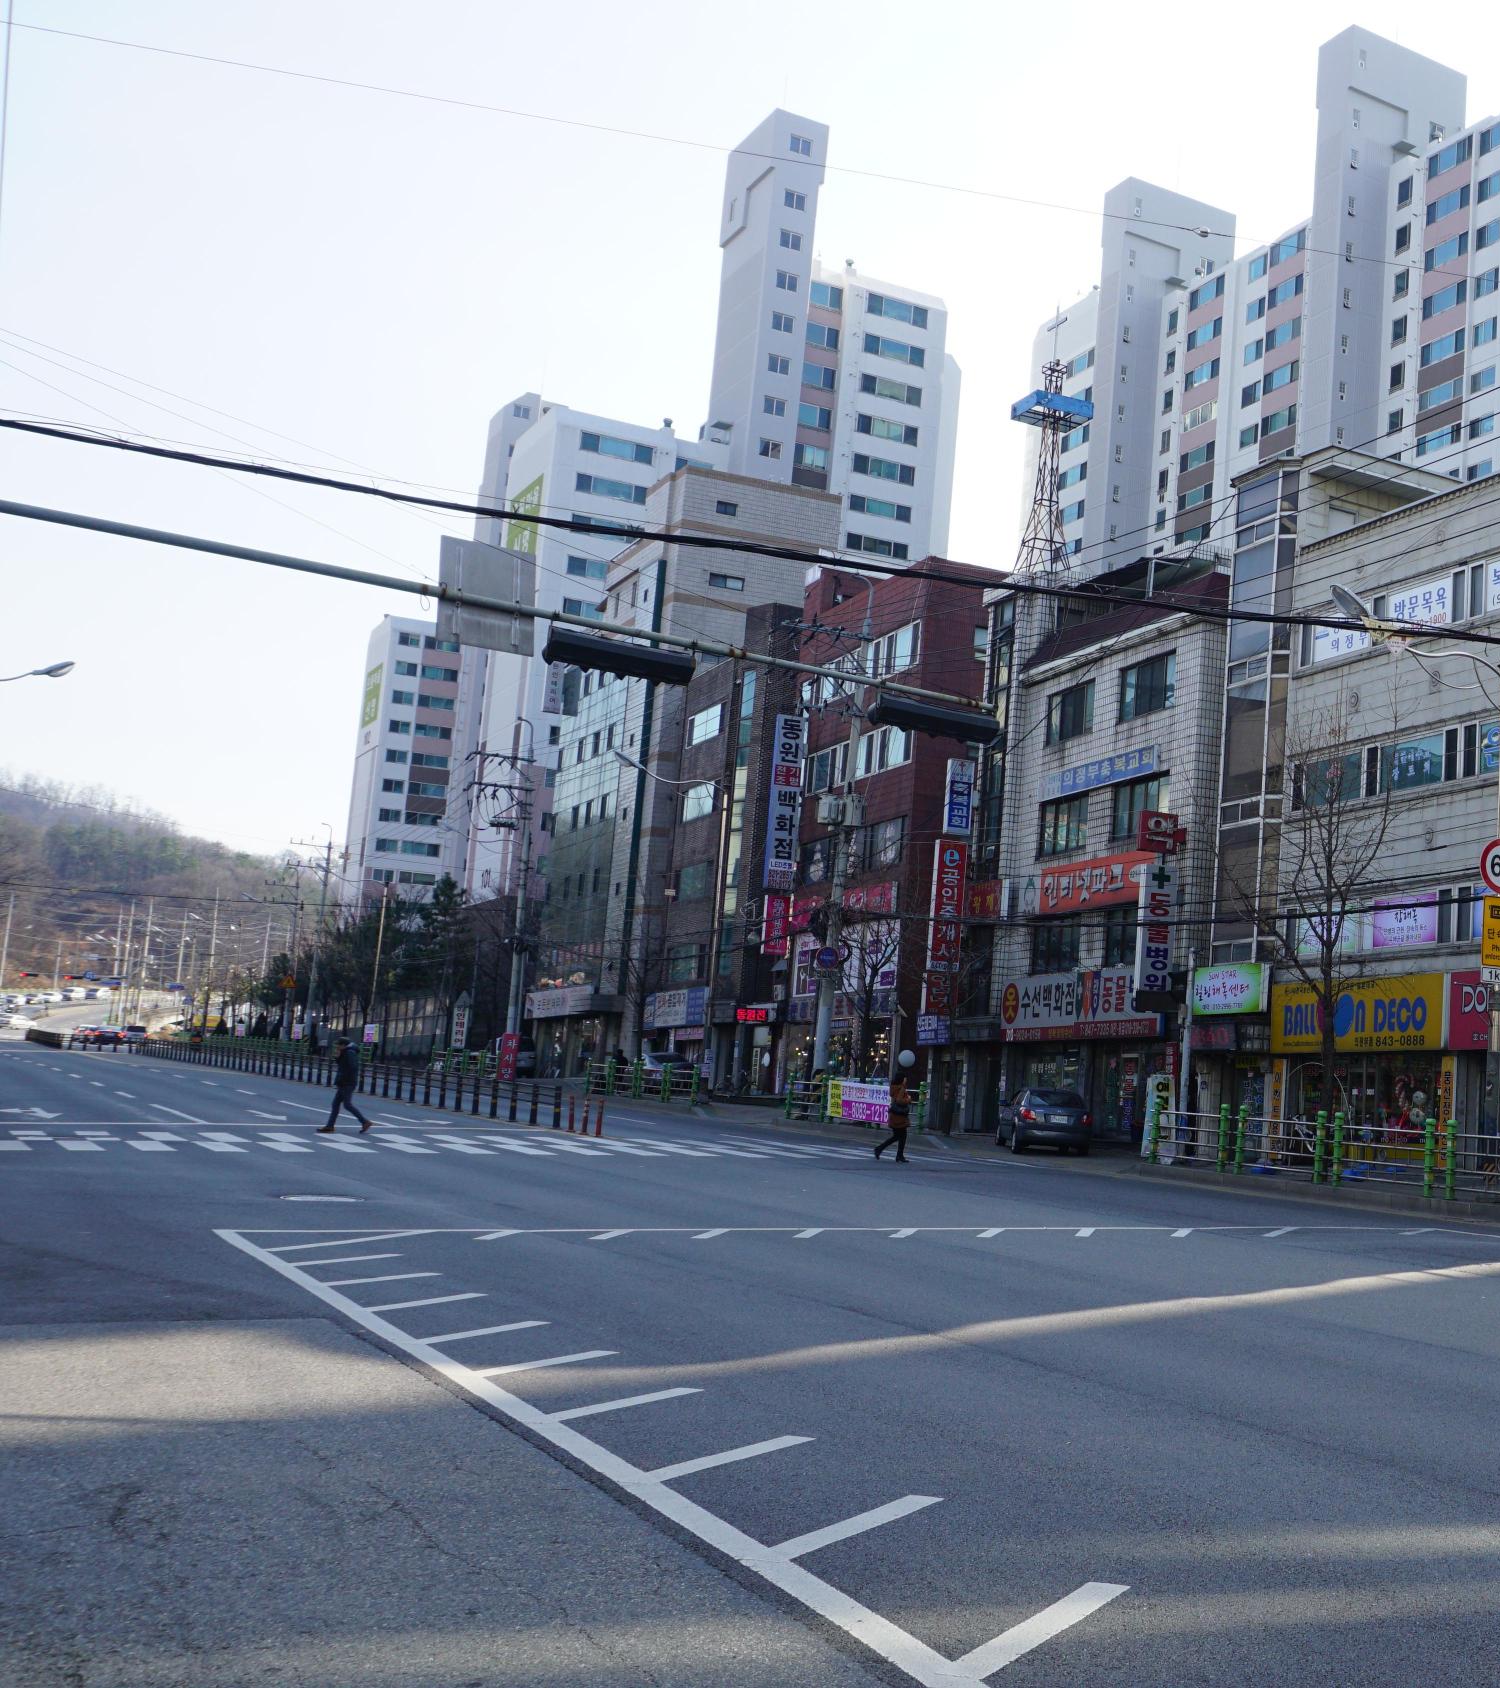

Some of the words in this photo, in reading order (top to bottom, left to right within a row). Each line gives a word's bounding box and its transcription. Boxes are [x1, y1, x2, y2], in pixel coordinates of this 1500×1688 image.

[1394, 587, 1447, 620] 방문목욕
[781, 718, 802, 764] 동원
[774, 790, 797, 861] 백화점
[1146, 816, 1175, 850] 약
[1020, 982, 1075, 1019] 수선백화점
[1373, 996, 1428, 1033] DECO
[502, 1038, 518, 1080] 차사랑
[1375, 1034, 1425, 1048] 843-0888
